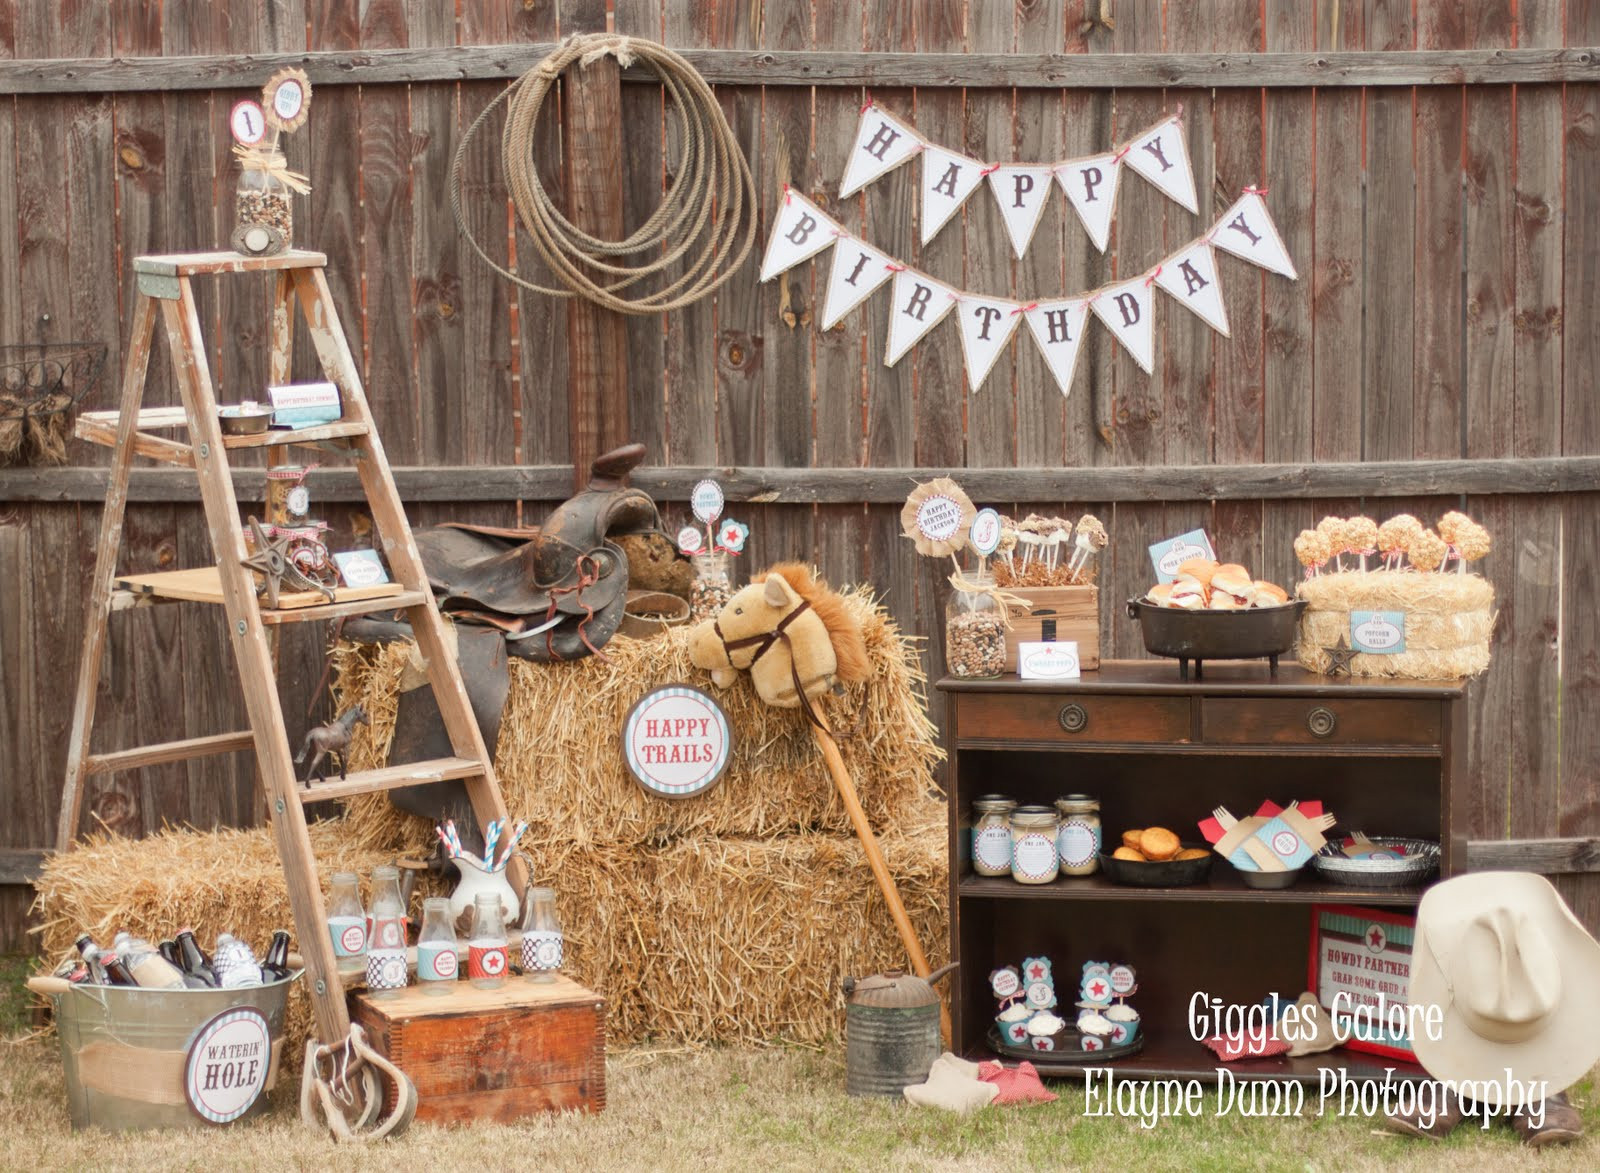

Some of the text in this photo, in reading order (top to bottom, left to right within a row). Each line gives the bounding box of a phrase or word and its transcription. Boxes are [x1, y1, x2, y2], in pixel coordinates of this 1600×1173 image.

[242, 111, 256, 137] 1
[863, 121, 1173, 208] HAPPY
[785, 212, 1262, 344] BIRTHDAY
[923, 508, 956, 527] BIRTHDAY
[926, 503, 947, 516] HAPPY
[930, 518, 956, 531] JACKSON
[1364, 630, 1389, 638] POPCORN
[646, 718, 710, 738] HAPPY
[641, 743, 713, 764] TRAILS
[1327, 948, 1362, 968] HOWDY
[1332, 971, 1353, 984] GRAB
[1354, 976, 1376, 989] SOME
[1378, 980, 1399, 995] GRUB
[208, 1040, 263, 1059] WATERIN'
[203, 1060, 259, 1090] HOLE
